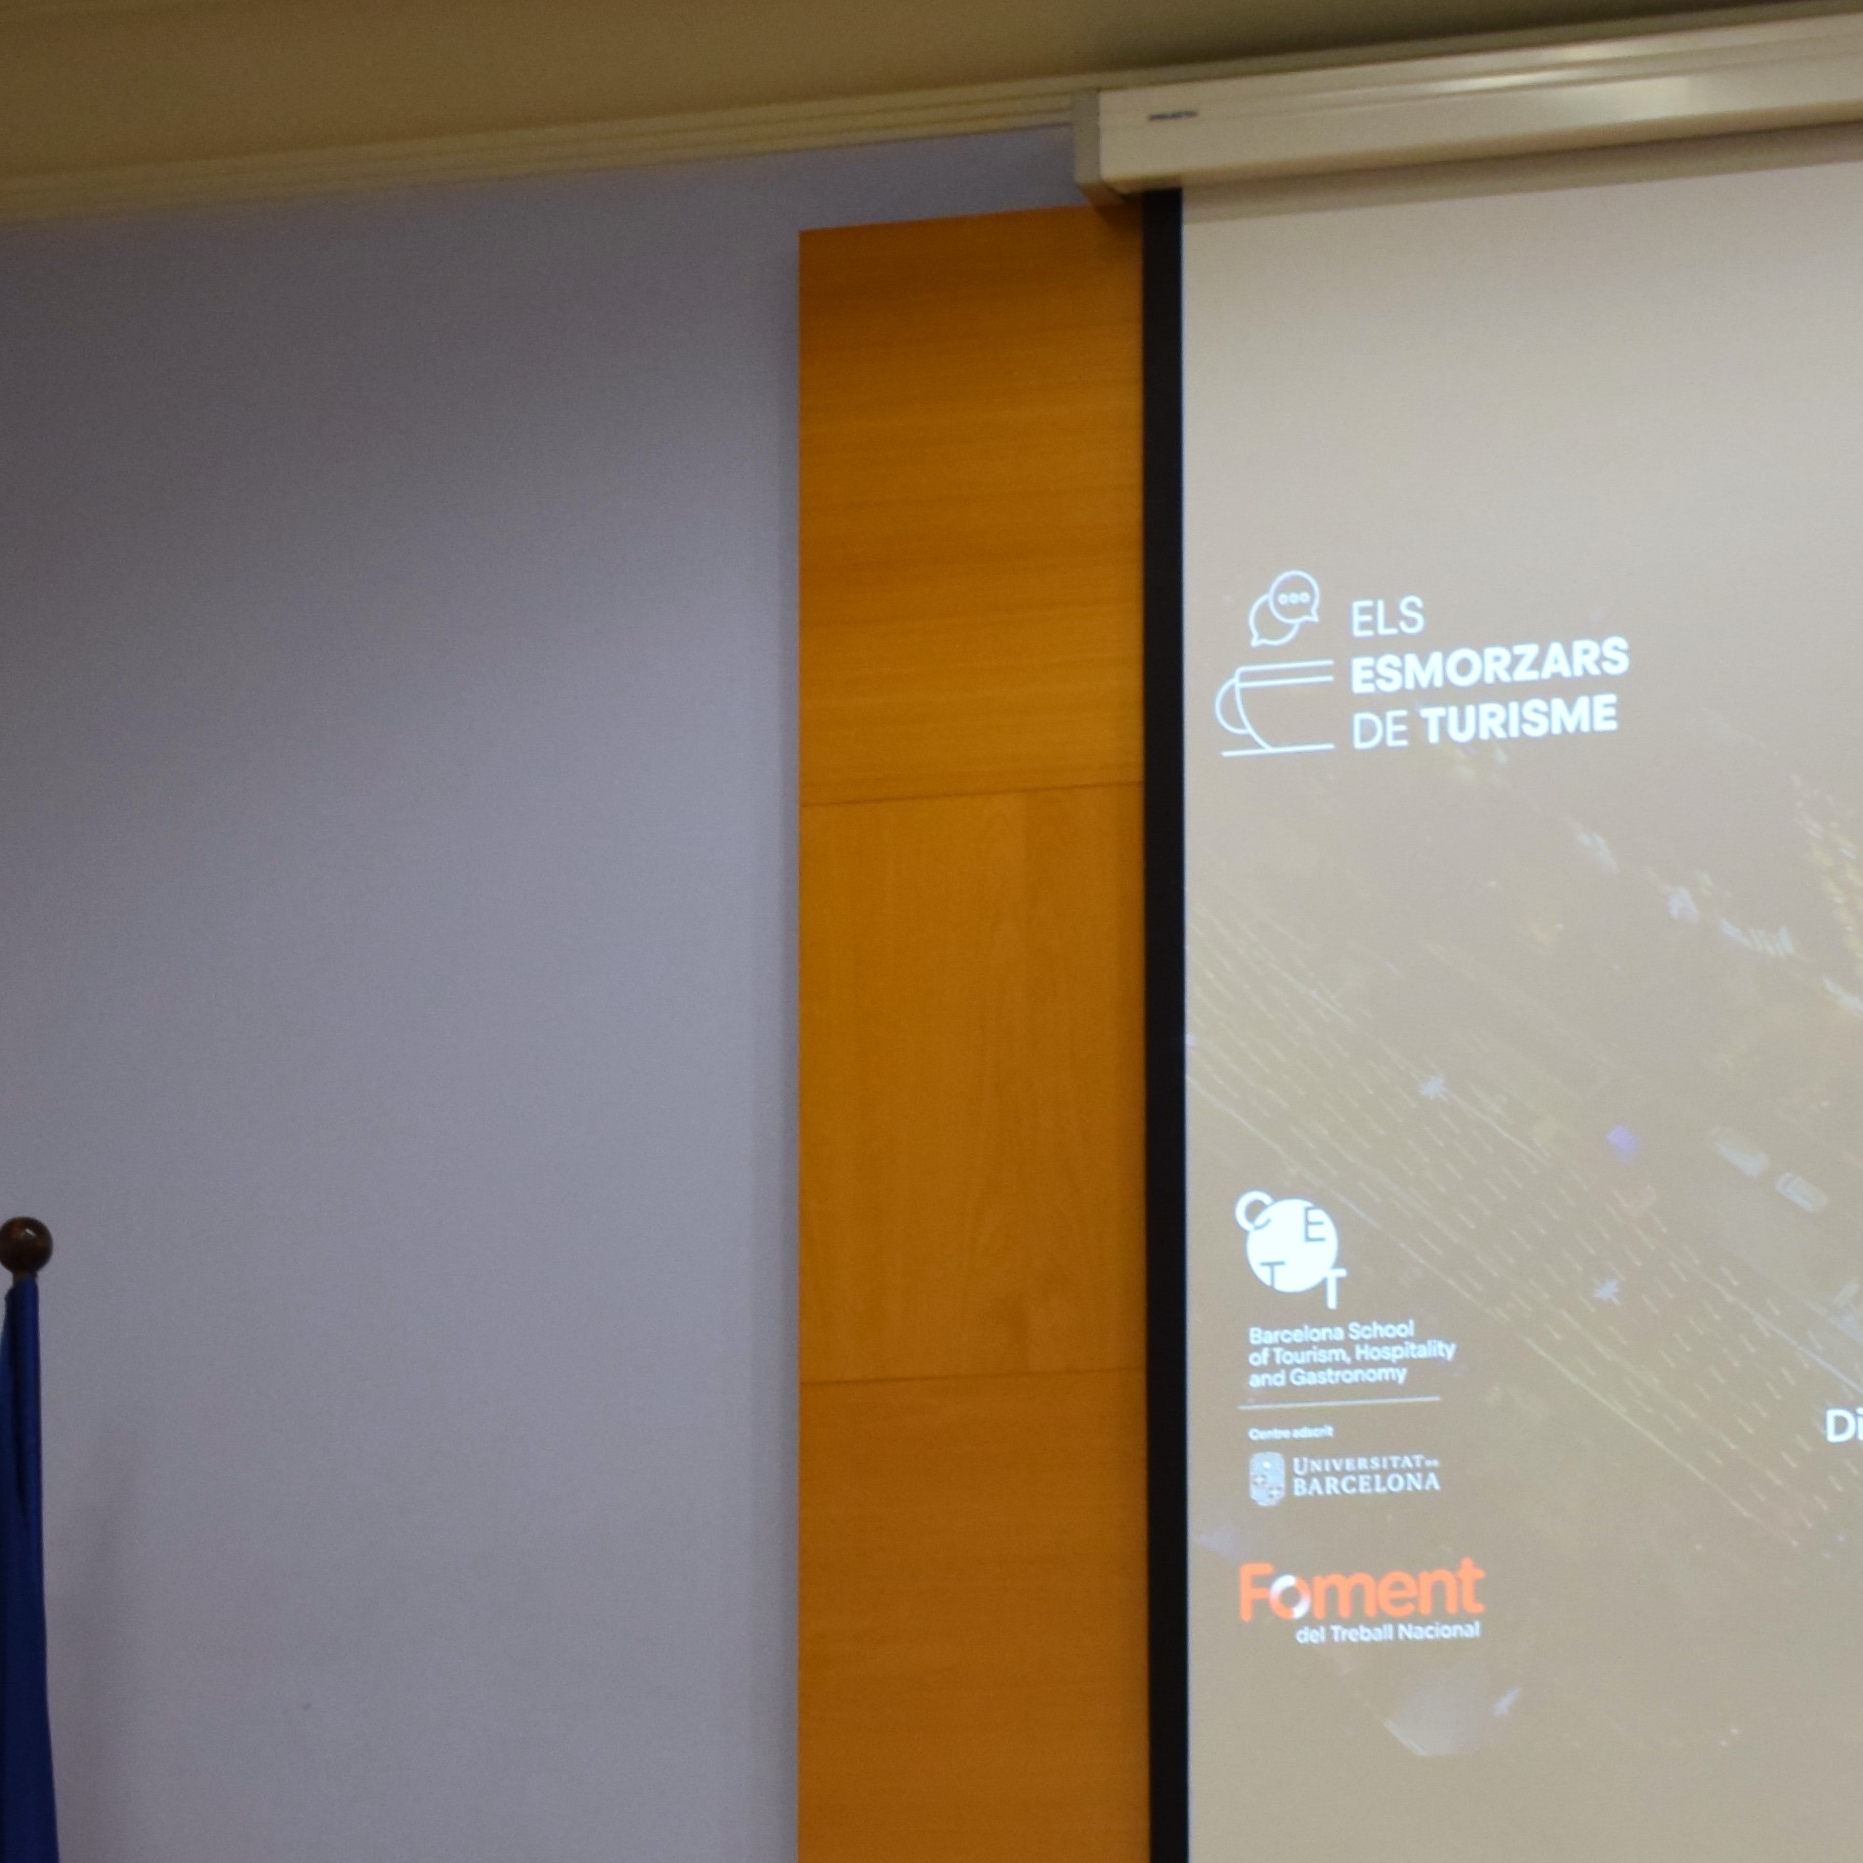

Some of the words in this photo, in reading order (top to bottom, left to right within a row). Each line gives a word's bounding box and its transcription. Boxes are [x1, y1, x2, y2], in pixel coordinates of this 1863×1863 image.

[1351, 596, 1425, 638] ELS
[1351, 636, 1630, 694] ESMORZARS
[1353, 709, 1409, 750] DE
[1420, 693, 1619, 744] TURISME
[1249, 1324, 1345, 1345] Barcelona
[1348, 1319, 1415, 1341] School
[1248, 1347, 1270, 1367] of
[1273, 1346, 1352, 1365] Tourism,
[1354, 1340, 1457, 1363] Hospitality
[1248, 1370, 1287, 1388] and
[1289, 1366, 1408, 1387] Gastronomy
[1293, 1453, 1425, 1475] UNIVERSITAT
[1293, 1471, 1441, 1496] BARCELONA
[1239, 1556, 1486, 1623] Foment
[1296, 1625, 1326, 1644] del
[1330, 1623, 1394, 1643] Treball
[1398, 1620, 1481, 1640] Nacional
